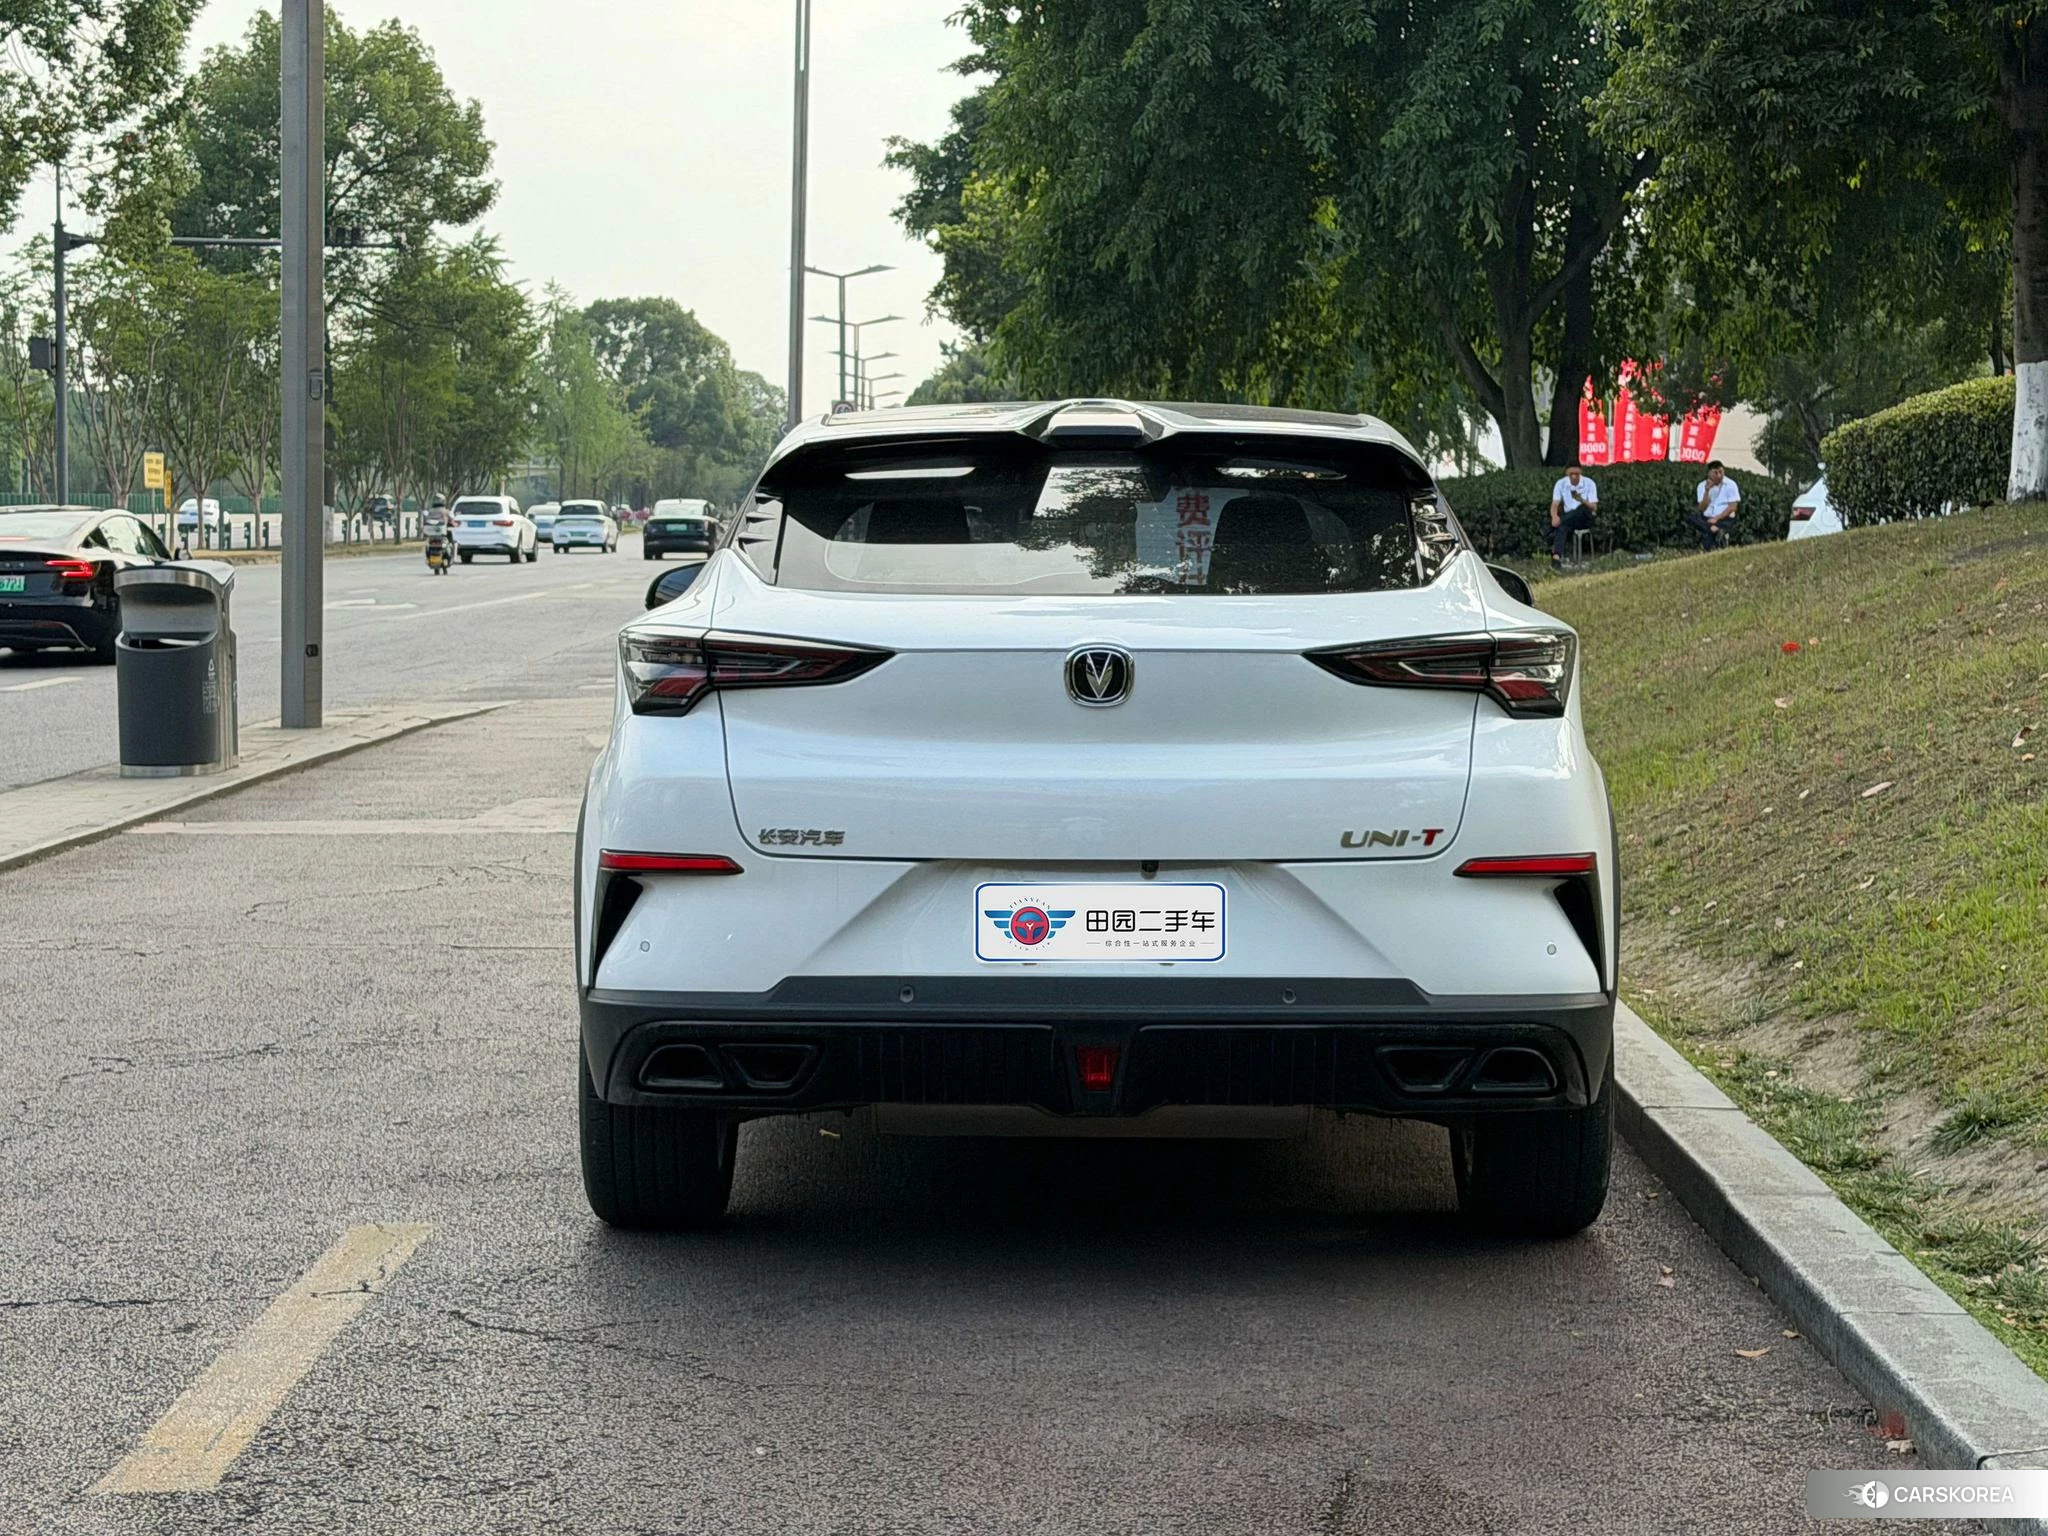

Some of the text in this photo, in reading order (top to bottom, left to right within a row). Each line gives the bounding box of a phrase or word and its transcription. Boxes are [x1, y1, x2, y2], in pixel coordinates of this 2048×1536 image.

[758, 828, 846, 846] 长安汽车
[1341, 828, 1444, 848] UNI-T
[1086, 909, 1215, 932] 田园二手车
[1104, 939, 1197, 948] 综合性一站式服务企业
